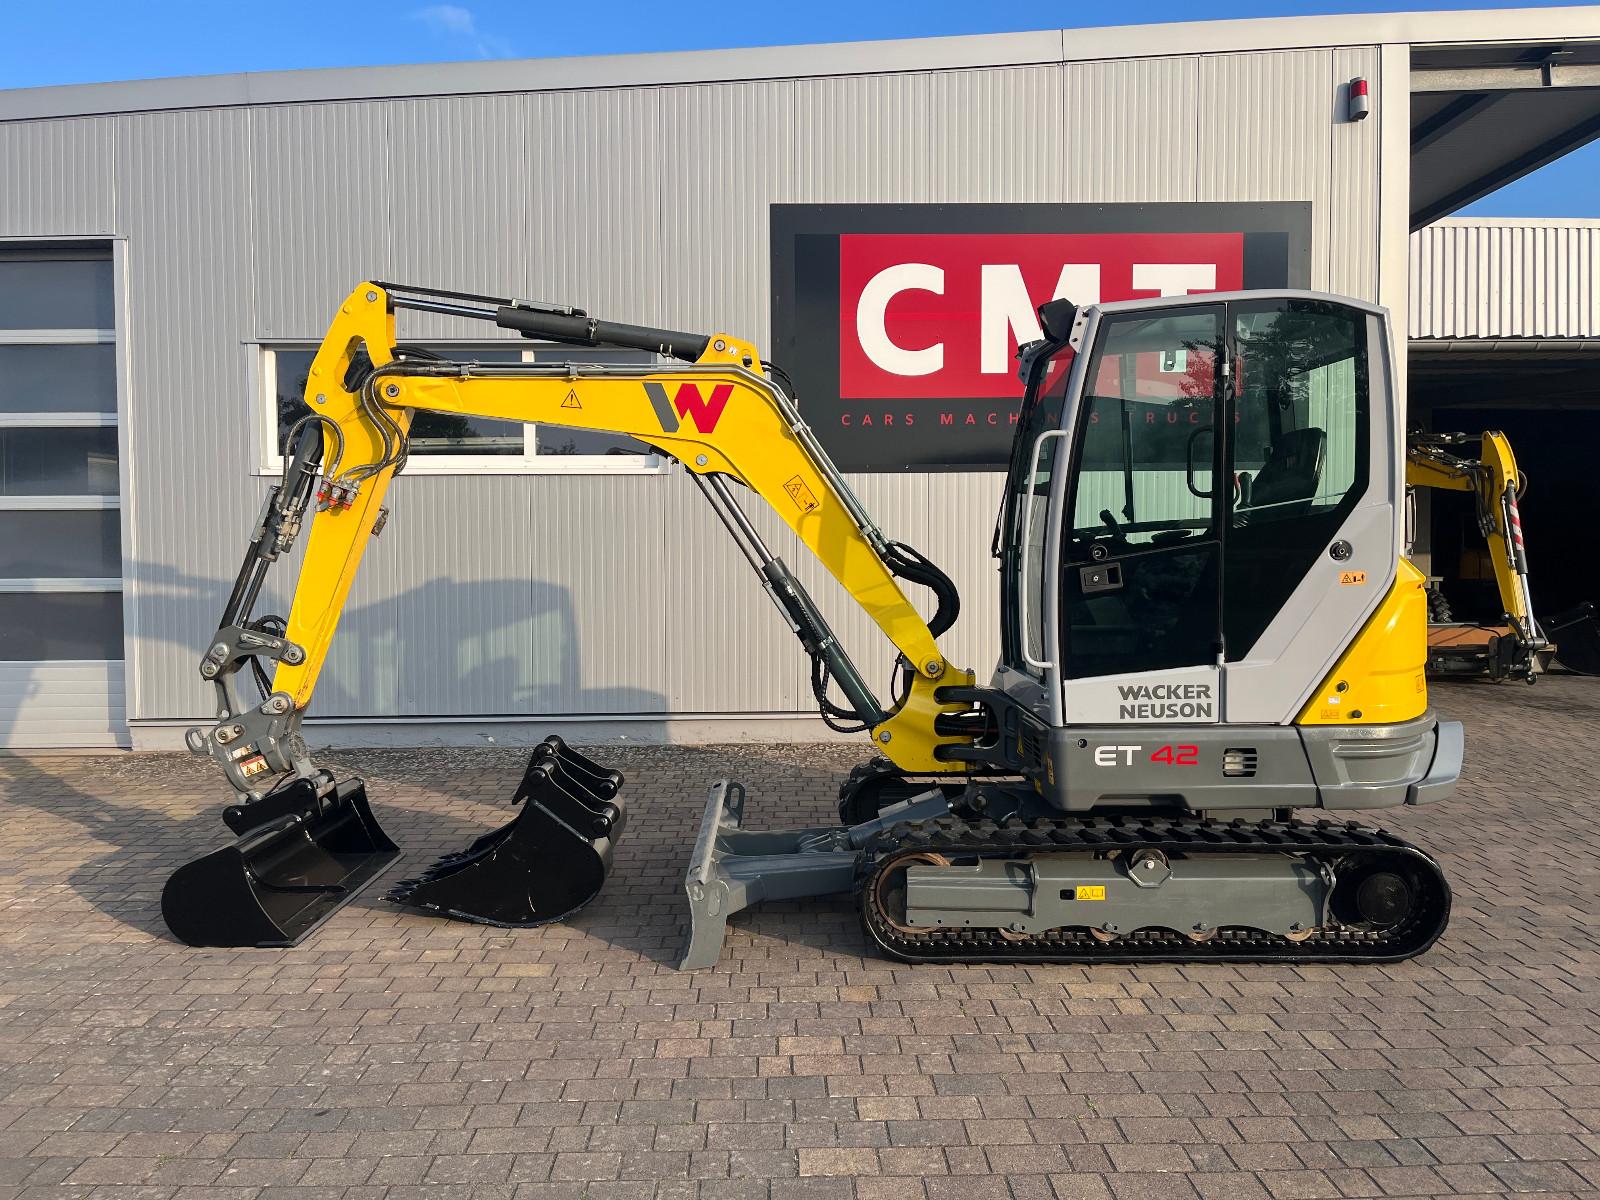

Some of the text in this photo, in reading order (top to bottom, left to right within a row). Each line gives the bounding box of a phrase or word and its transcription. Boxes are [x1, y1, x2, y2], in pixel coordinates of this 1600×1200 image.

[856, 263, 1217, 376] CMT
[841, 411, 1241, 427] CARS MACHNS RUCS
[1118, 684, 1212, 701] WACKER
[1119, 703, 1212, 719] NEUSON
[1094, 744, 1199, 767] ET 42
